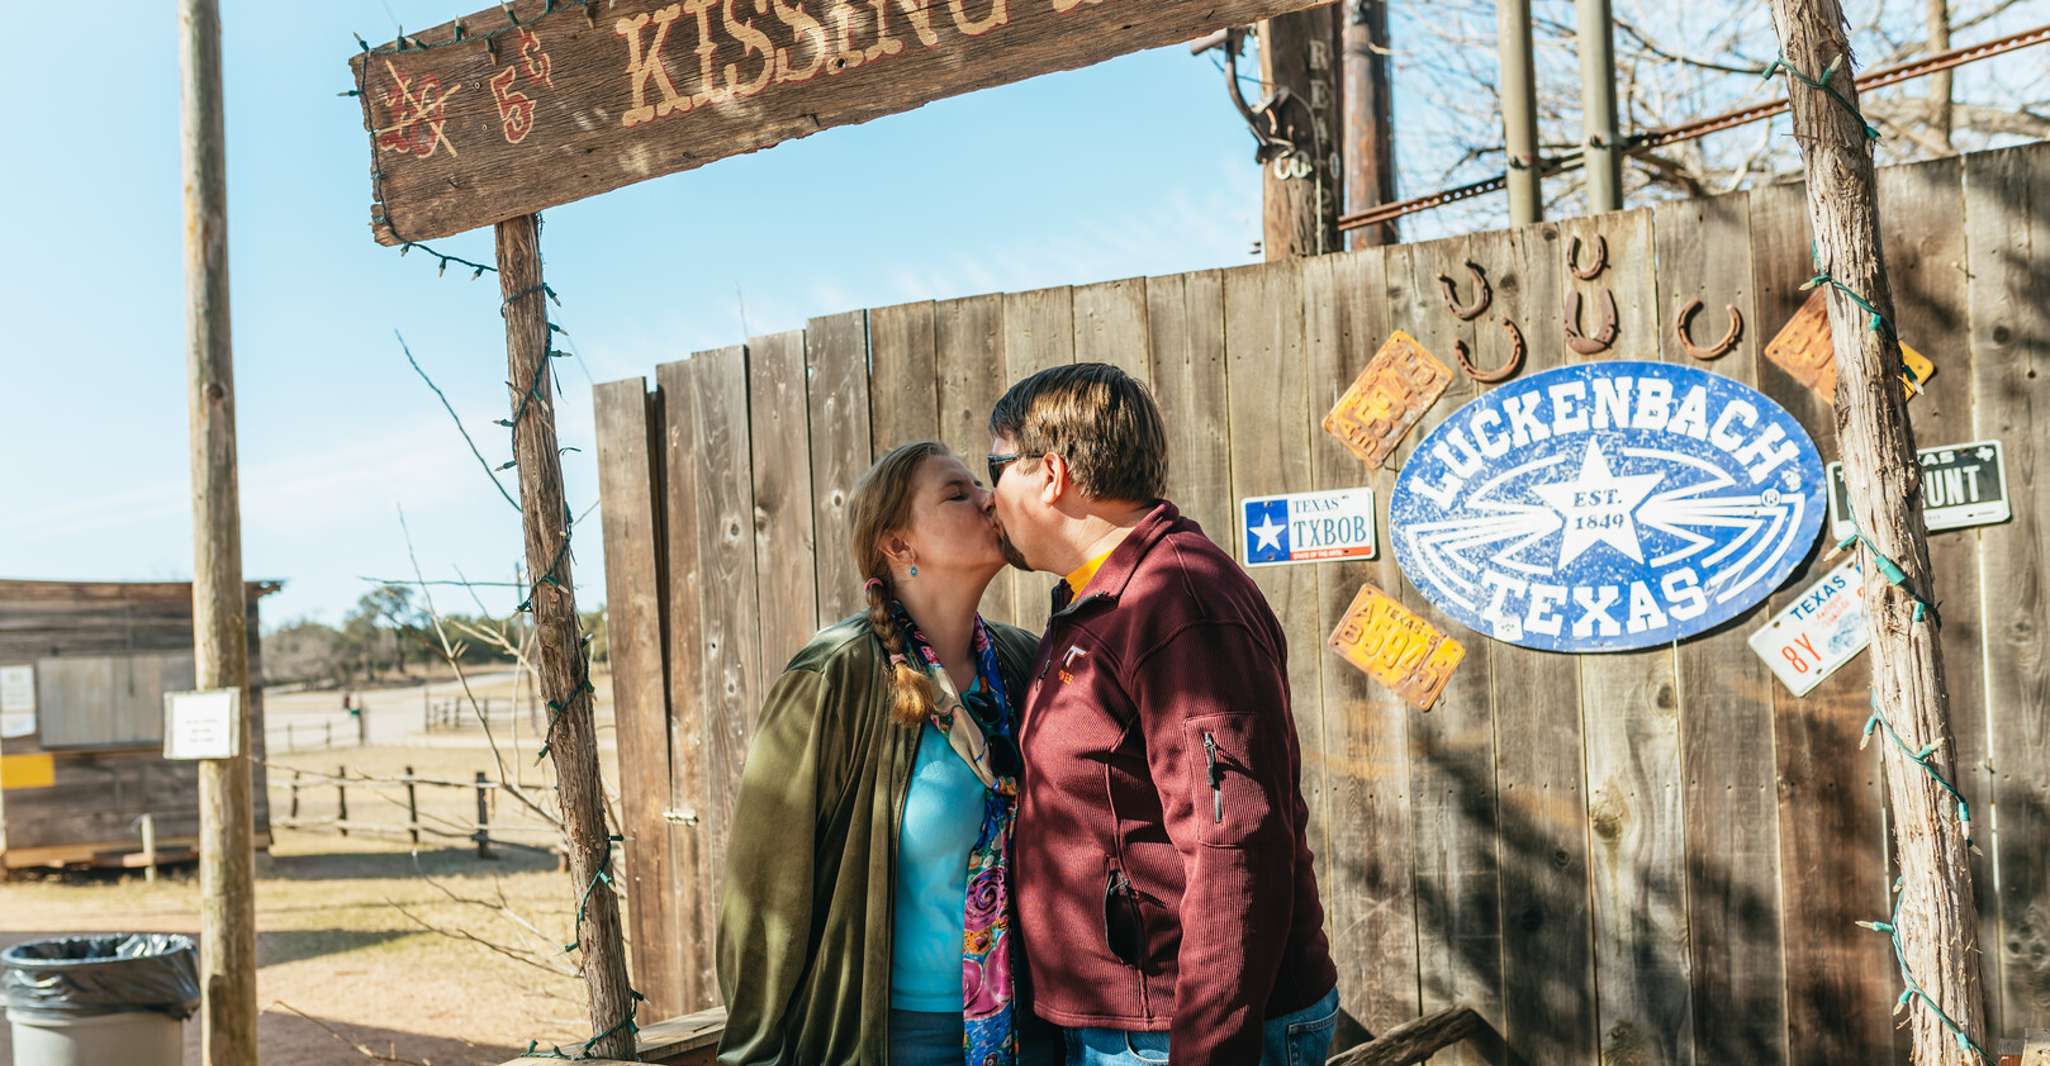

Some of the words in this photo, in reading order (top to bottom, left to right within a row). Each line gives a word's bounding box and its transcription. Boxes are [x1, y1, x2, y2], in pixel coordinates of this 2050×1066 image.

[1409, 376, 1801, 510] LUCKENBACH
[1293, 498, 1340, 514] TEXAS
[1573, 488, 1623, 508] EST.
[1293, 515, 1367, 549] TXBOB
[1576, 513, 1625, 531] 1849
[1480, 566, 1708, 641] TEXAS
[1790, 575, 1847, 621] TEXAS
[1384, 605, 1424, 635] TEXAS
[1781, 632, 1822, 674] 8Y
